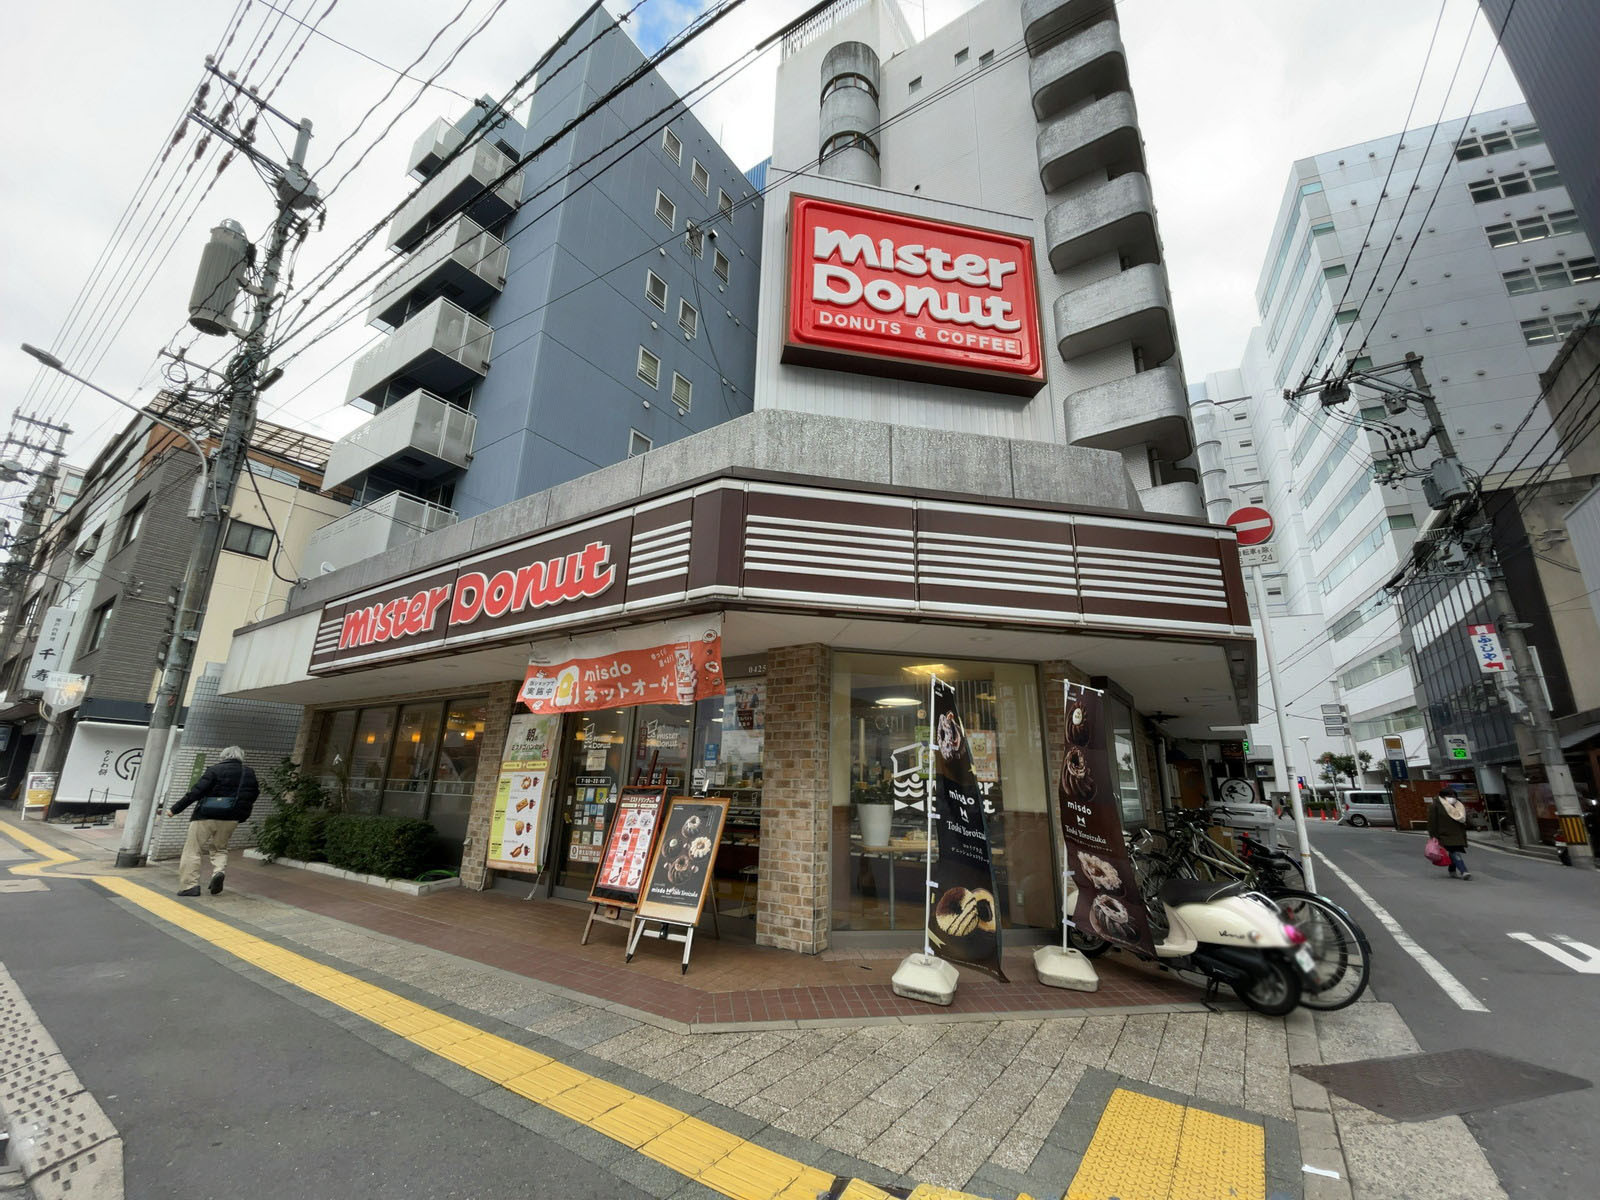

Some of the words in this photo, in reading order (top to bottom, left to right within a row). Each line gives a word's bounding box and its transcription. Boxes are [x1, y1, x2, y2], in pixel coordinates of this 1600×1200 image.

[812, 263, 1021, 332] Donut
[819, 311, 901, 335] DONUTS
[915, 326, 927, 340] &
[937, 330, 1017, 354] COFFEE
[1240, 546, 1273, 556] 転車を除く
[449, 541, 616, 625] Donut
[32, 648, 57, 682] 千寿
[584, 660, 633, 683] misdo
[1067, 800, 1092, 816] misdo
